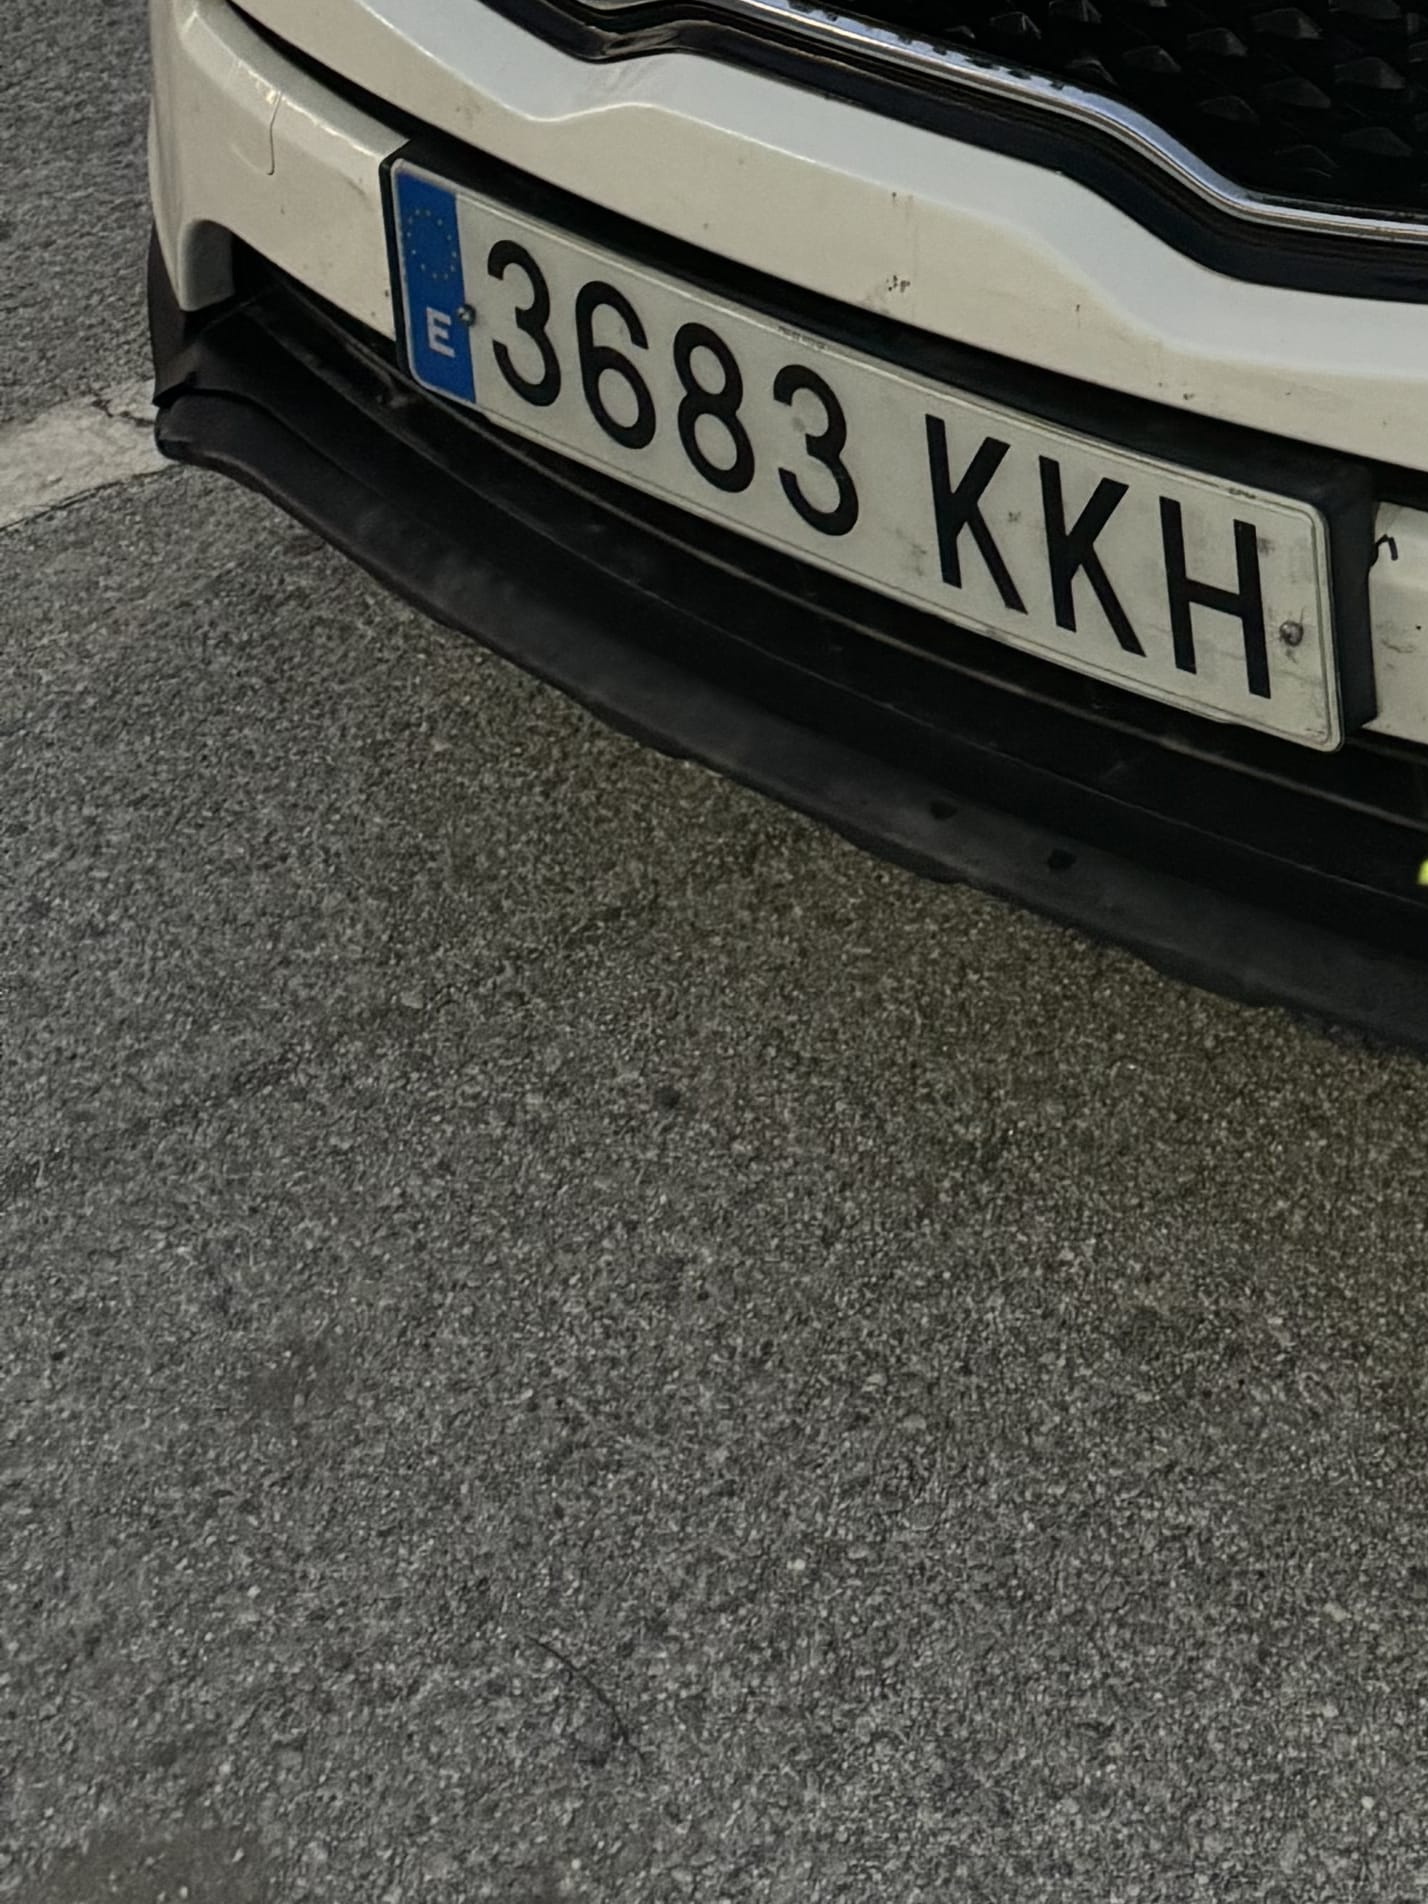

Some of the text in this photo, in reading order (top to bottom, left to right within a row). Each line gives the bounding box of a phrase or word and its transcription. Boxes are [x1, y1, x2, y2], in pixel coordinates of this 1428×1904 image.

[427, 305, 456, 359] E
[486, 239, 1271, 700] 3683 KKH
